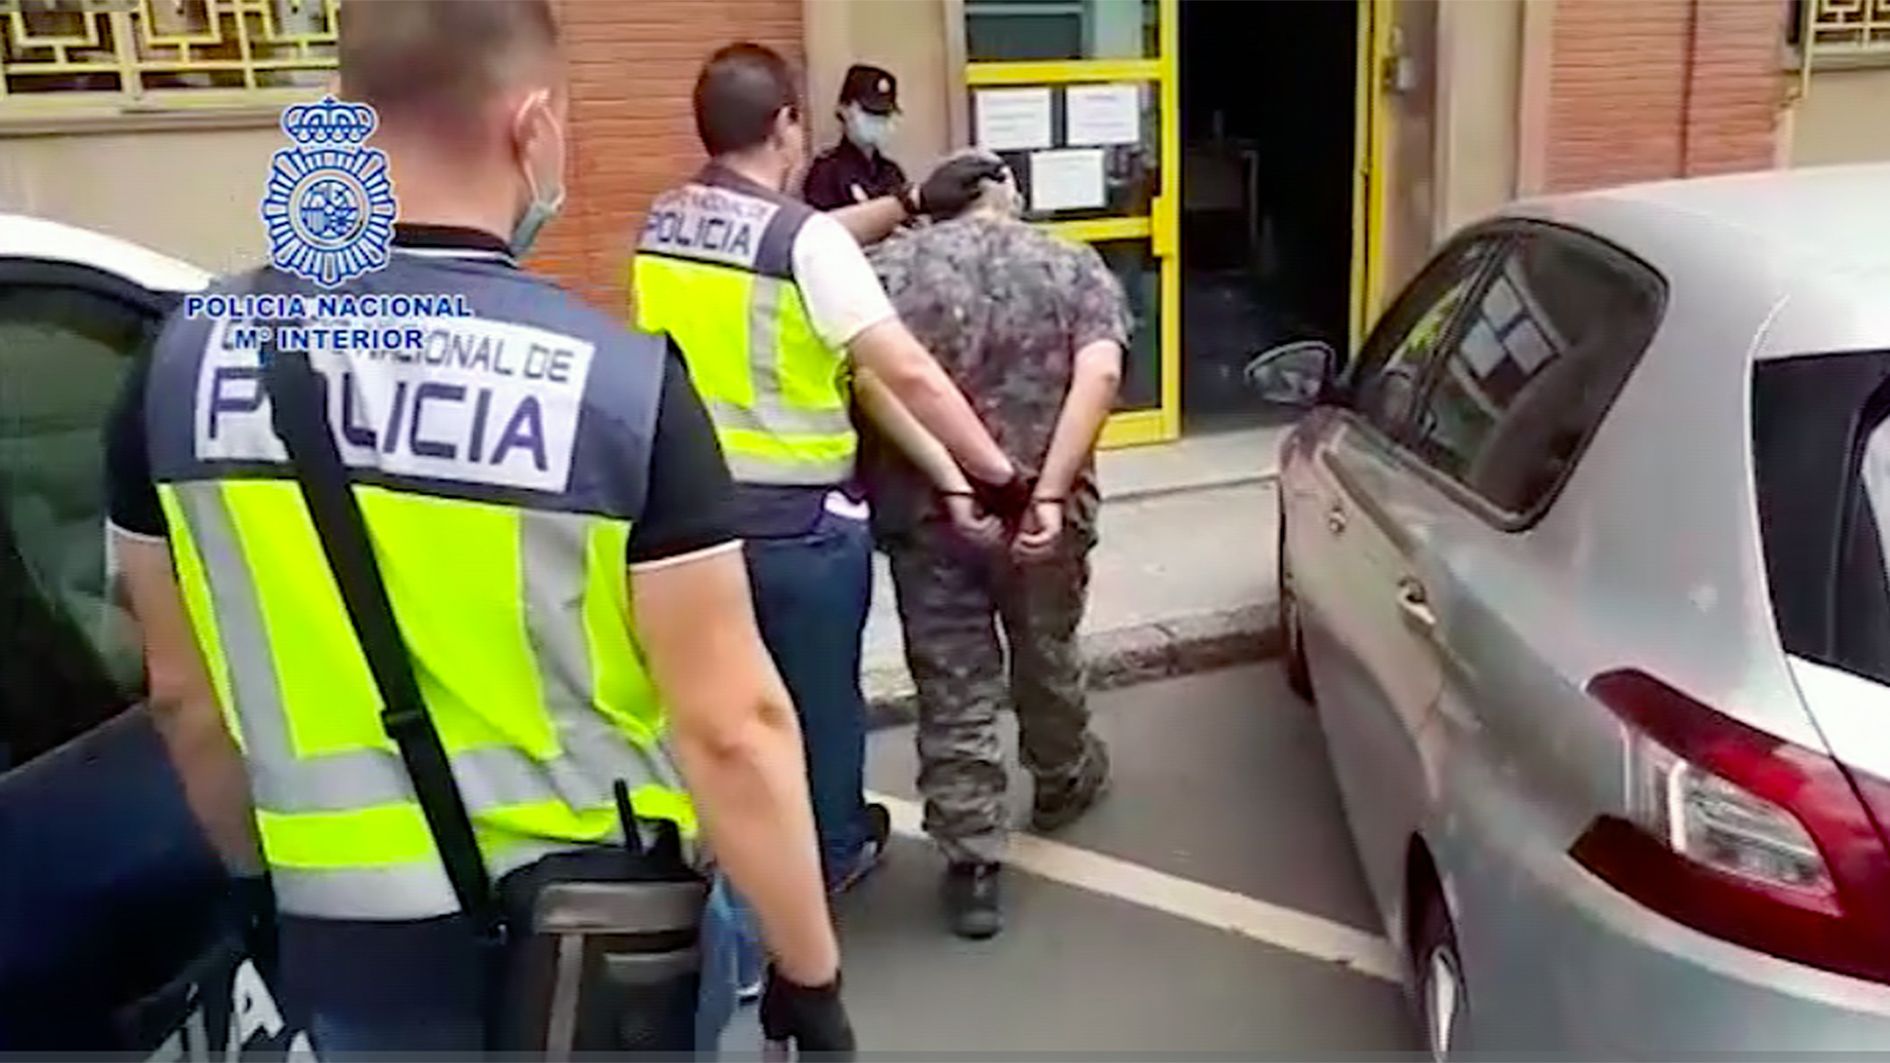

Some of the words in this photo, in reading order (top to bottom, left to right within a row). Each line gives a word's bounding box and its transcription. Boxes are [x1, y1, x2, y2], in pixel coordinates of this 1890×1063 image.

[637, 211, 751, 256] POLICIA
[523, 343, 575, 382] DE
[209, 367, 548, 472] PLICIA
